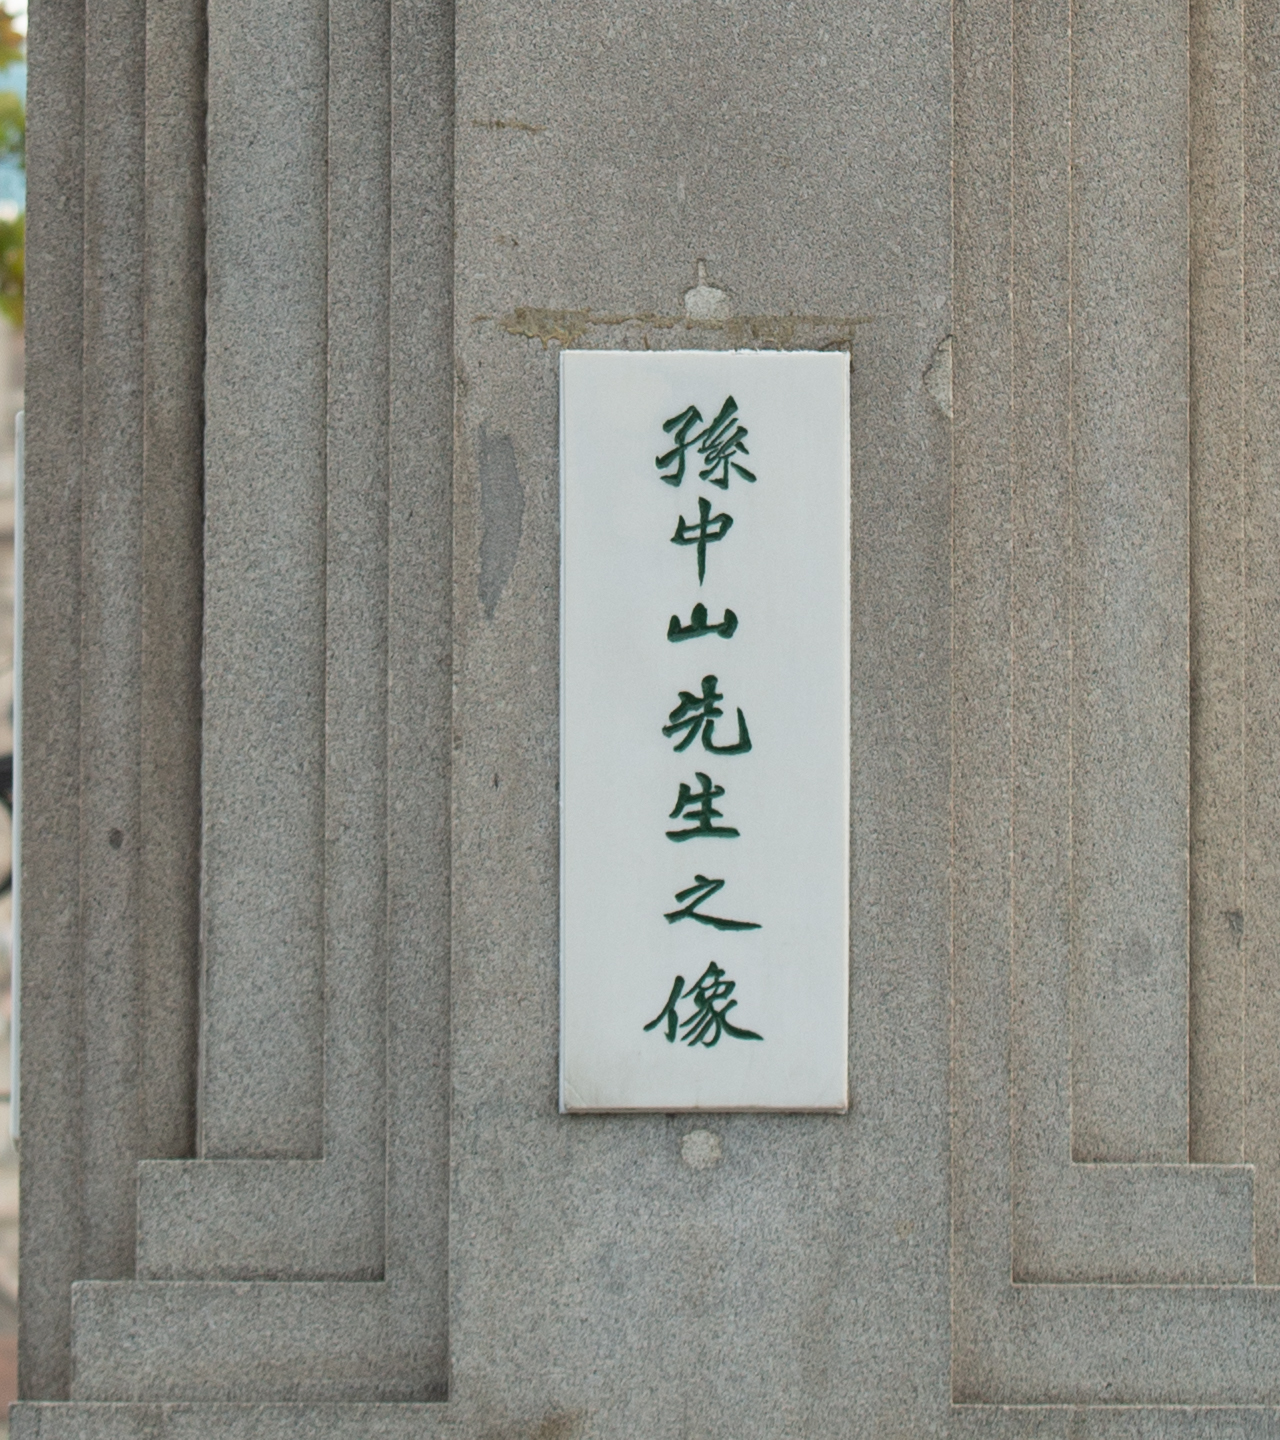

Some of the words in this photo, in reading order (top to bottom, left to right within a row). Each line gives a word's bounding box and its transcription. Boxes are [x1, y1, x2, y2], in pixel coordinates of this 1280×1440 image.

[643, 395, 764, 1048] 孫中山先生之像
